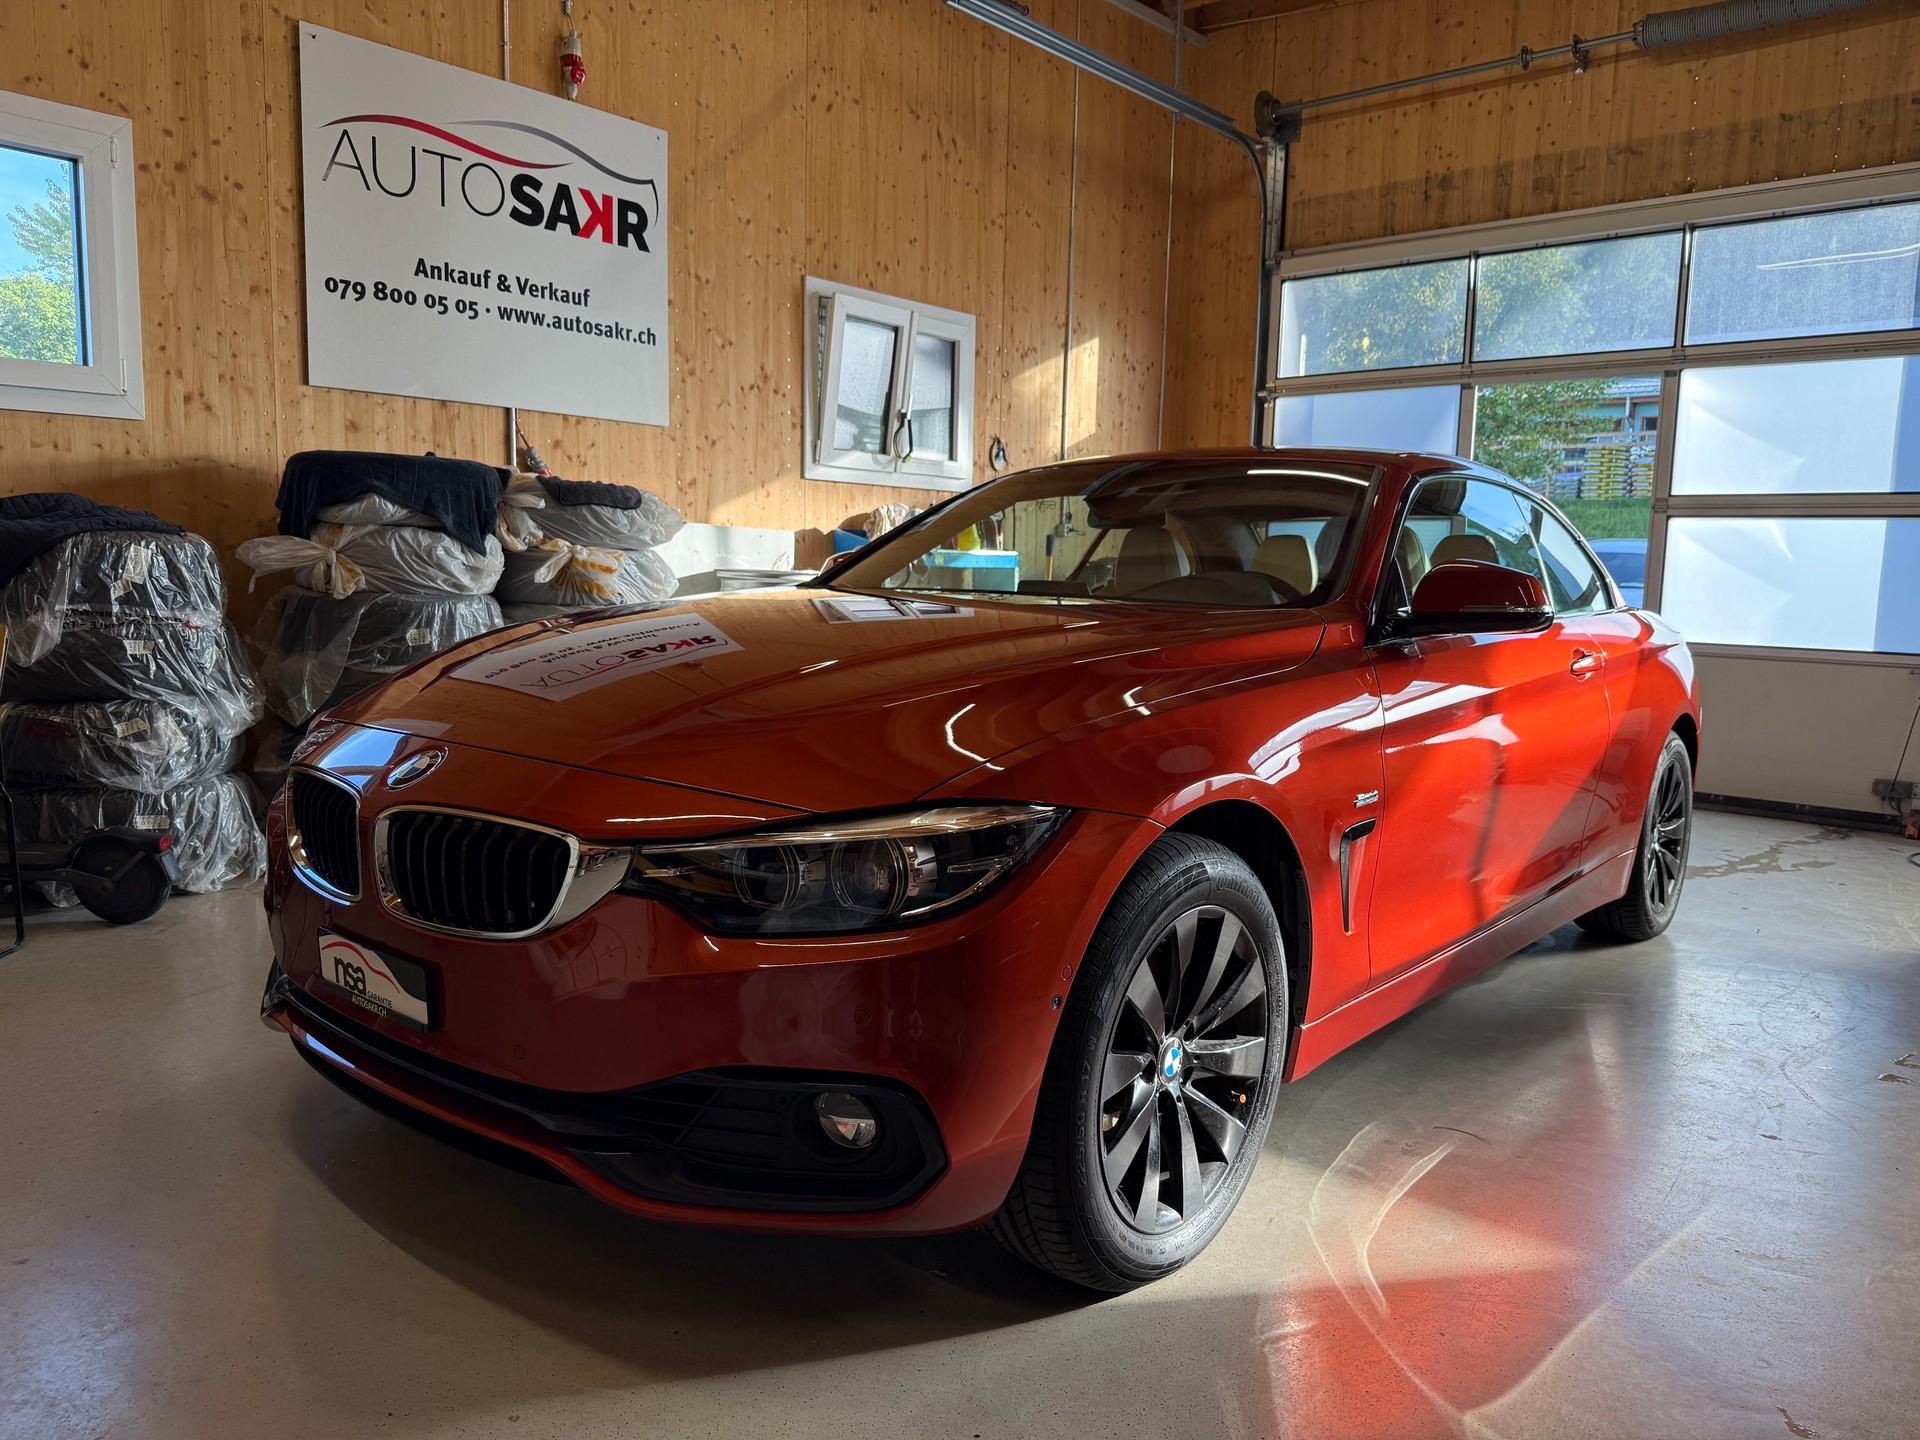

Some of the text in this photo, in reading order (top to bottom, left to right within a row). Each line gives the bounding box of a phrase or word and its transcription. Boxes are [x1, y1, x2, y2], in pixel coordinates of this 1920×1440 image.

[322, 128, 651, 254] AUTOSAKR
[324, 276, 367, 302] 079
[373, 280, 417, 306] 800
[423, 293, 449, 316] 05
[455, 298, 479, 321] 05
[497, 305, 657, 347] www.autosakr.ch
[413, 257, 591, 307] Ankauf & Verkauf
[334, 956, 366, 996] nsa
